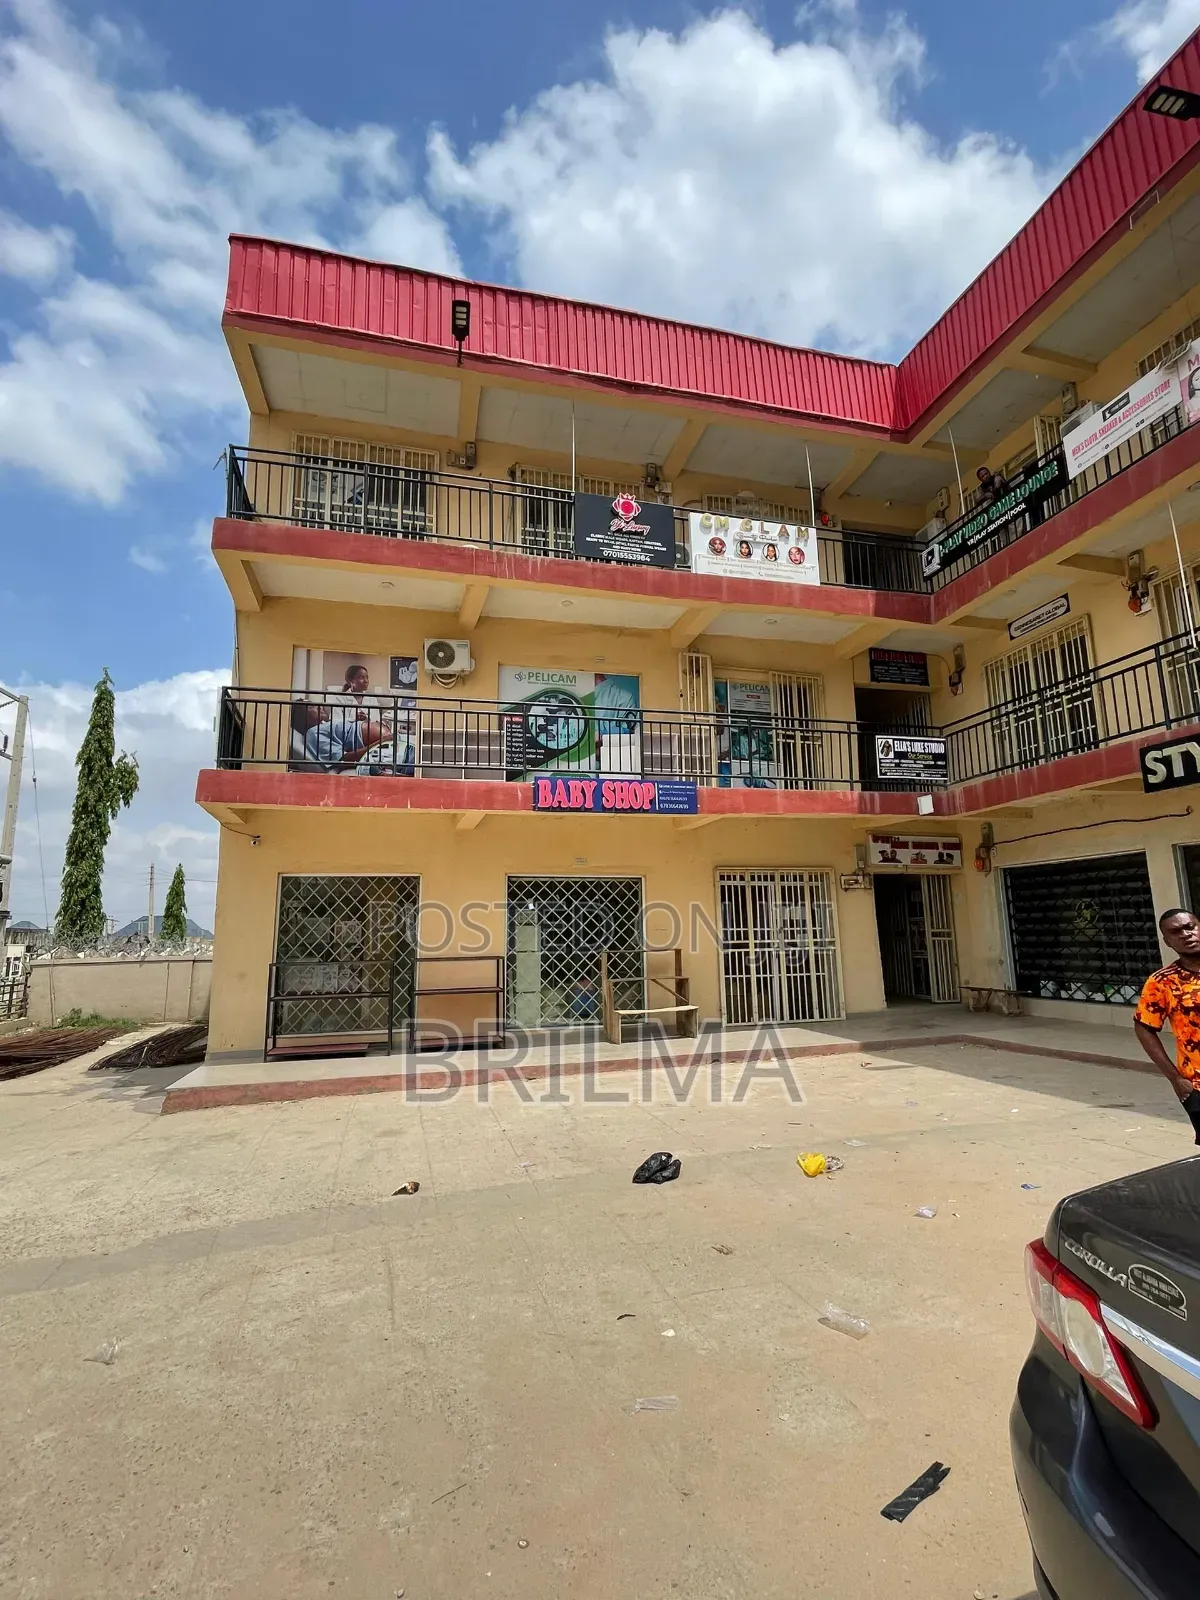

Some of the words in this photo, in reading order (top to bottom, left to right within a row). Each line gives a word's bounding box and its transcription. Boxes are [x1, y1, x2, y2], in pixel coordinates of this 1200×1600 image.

[1121, 391, 1155, 420] ACCESSORIES
[1154, 378, 1171, 400] STORE
[988, 491, 1016, 521] GAME
[1015, 460, 1059, 502] LOUNGE
[699, 512, 730, 531] CM
[602, 550, 651, 562] 07015553984
[1045, 602, 1067, 616] GLOBAL
[527, 671, 577, 684] PELICAM
[894, 740, 912, 752] ELLA'S
[925, 742, 945, 754] STUDIO
[537, 779, 598, 808] BABY
[602, 781, 655, 810] SHOP
[1064, 1239, 1128, 1288] COROLLA
